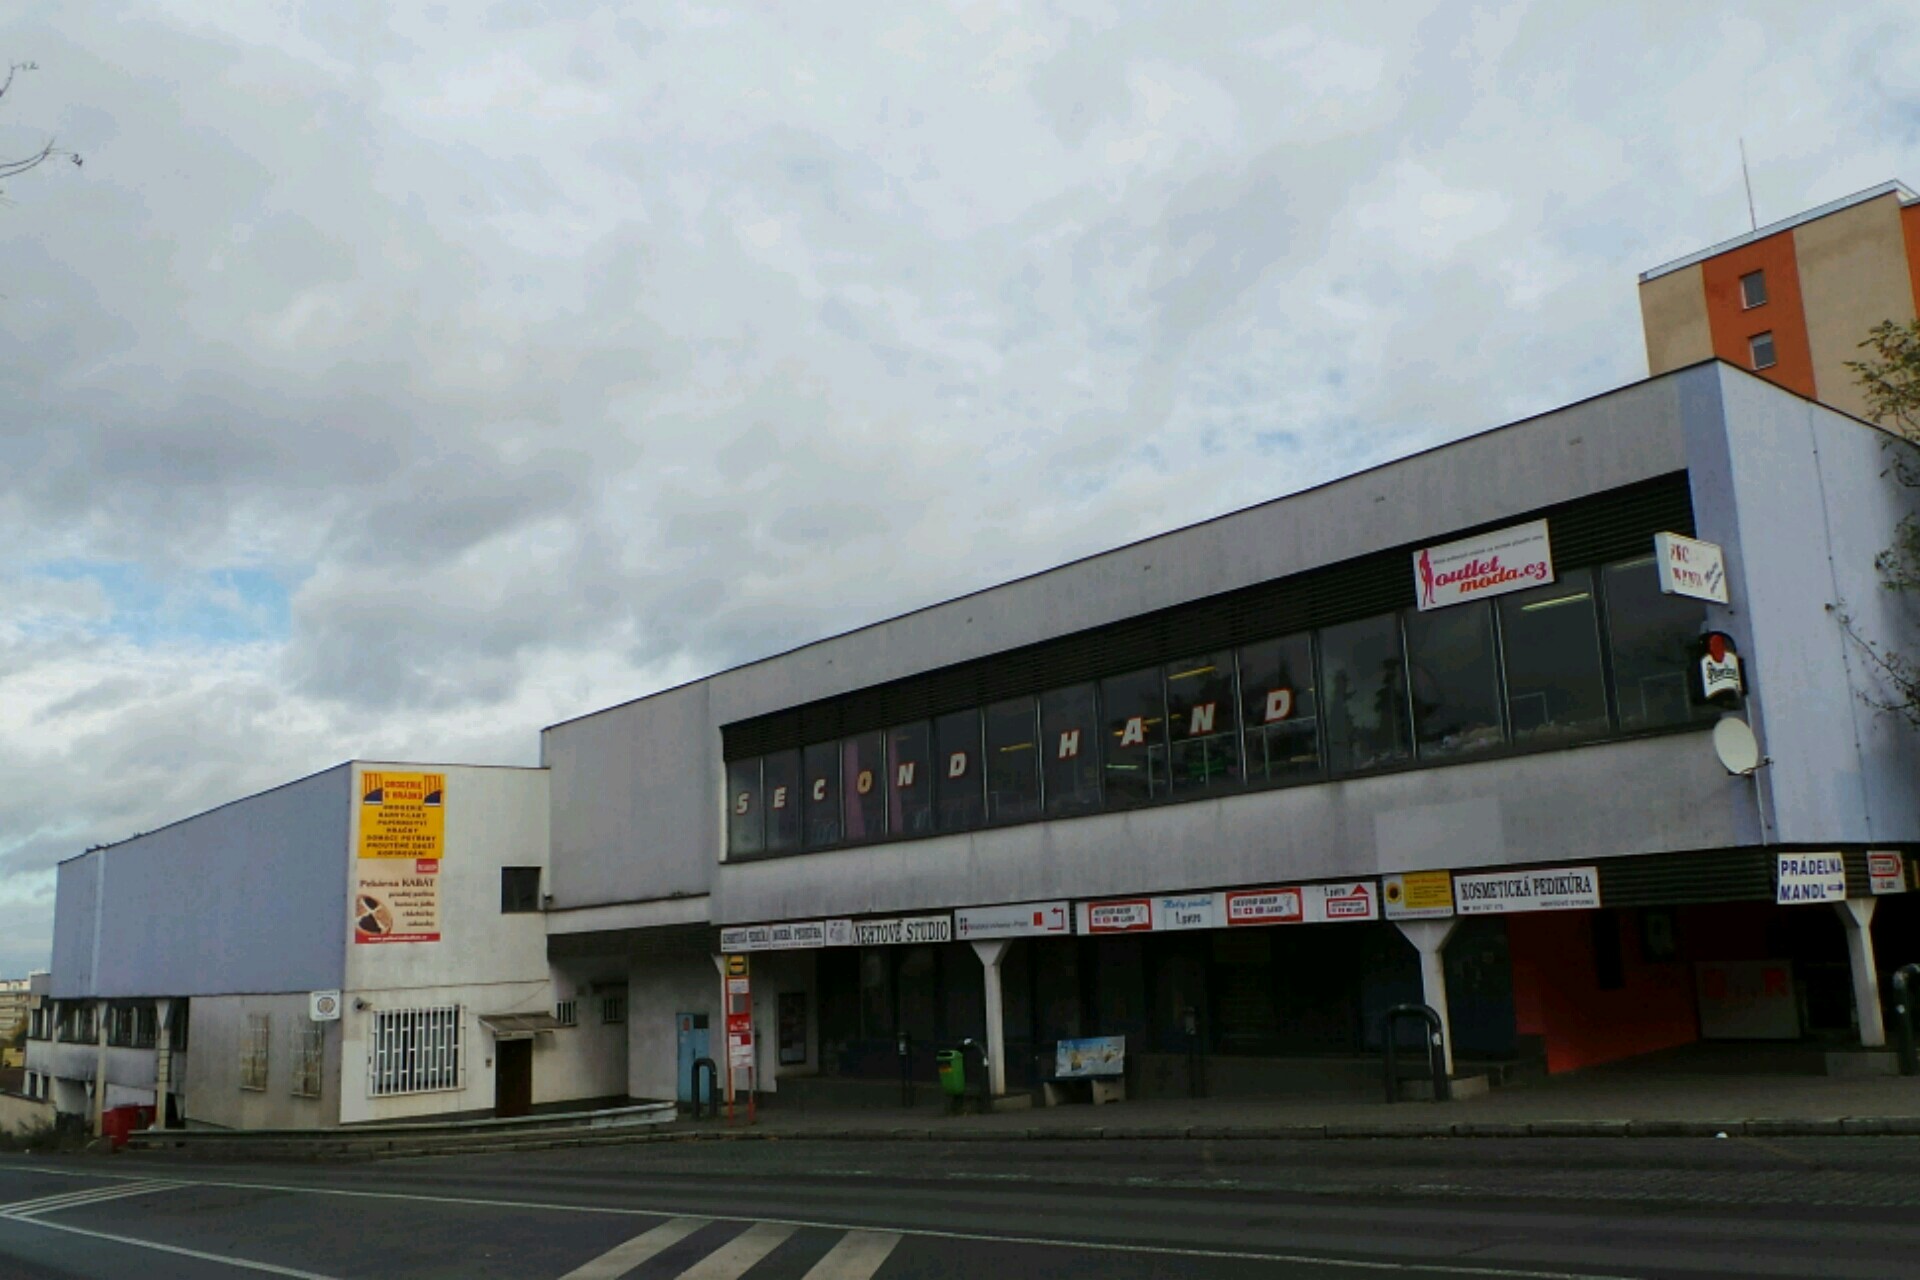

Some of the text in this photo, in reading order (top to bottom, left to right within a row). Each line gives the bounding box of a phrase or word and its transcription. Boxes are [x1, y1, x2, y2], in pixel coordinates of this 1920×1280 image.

[1435, 555, 1501, 587] outlet
[1459, 561, 1547, 594] moda.cz
[736, 686, 1294, 815] SECOND HAND
[1460, 876, 1530, 901] KOSMETICKÁ
[1532, 872, 1592, 896] PEDIKÚRA
[1779, 884, 1827, 901] MANDL
[906, 920, 948, 942] STUDIO
